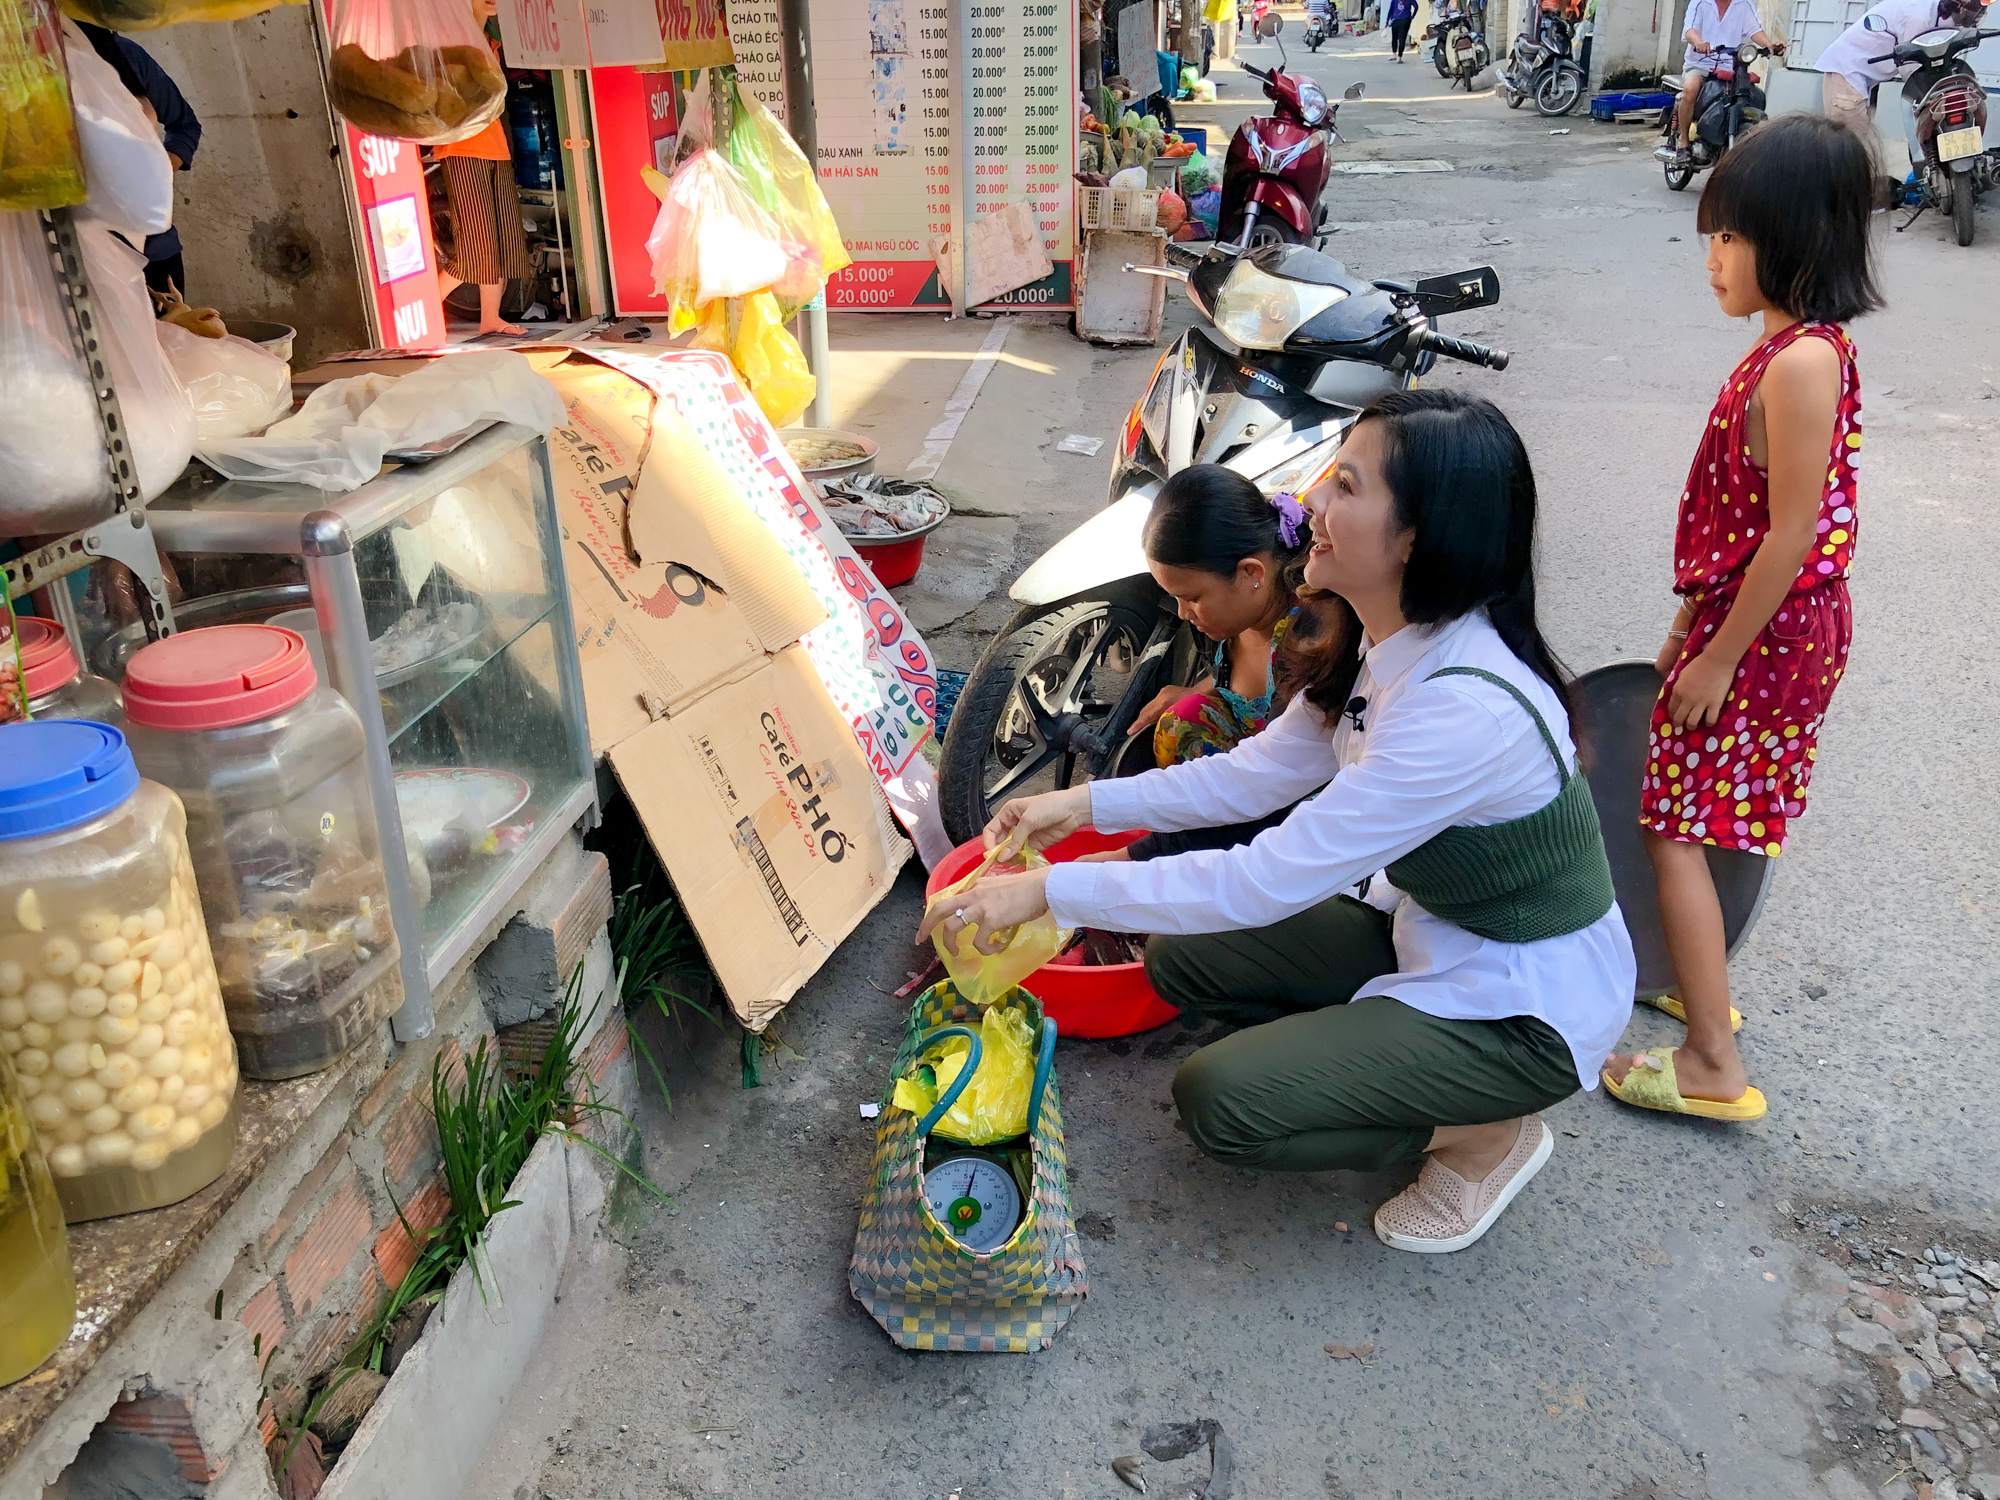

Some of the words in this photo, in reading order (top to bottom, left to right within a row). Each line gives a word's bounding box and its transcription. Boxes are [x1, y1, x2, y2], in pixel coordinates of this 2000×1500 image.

[731, 11, 761, 24] CHÁO
[733, 31, 762, 44] CHÁO
[736, 70, 765, 83] CHÁO
[650, 84, 670, 121] SÚP
[839, 147, 863, 158] XANH
[856, 241, 873, 251] MAI
[1239, 366, 1285, 394] HONDA
[555, 421, 613, 474] afé
[835, 556, 937, 719] 50%
[745, 638, 756, 652] VN
[760, 711, 795, 767] Café
[786, 763, 856, 864] PHỐ
[322, 817, 331, 830] 10
